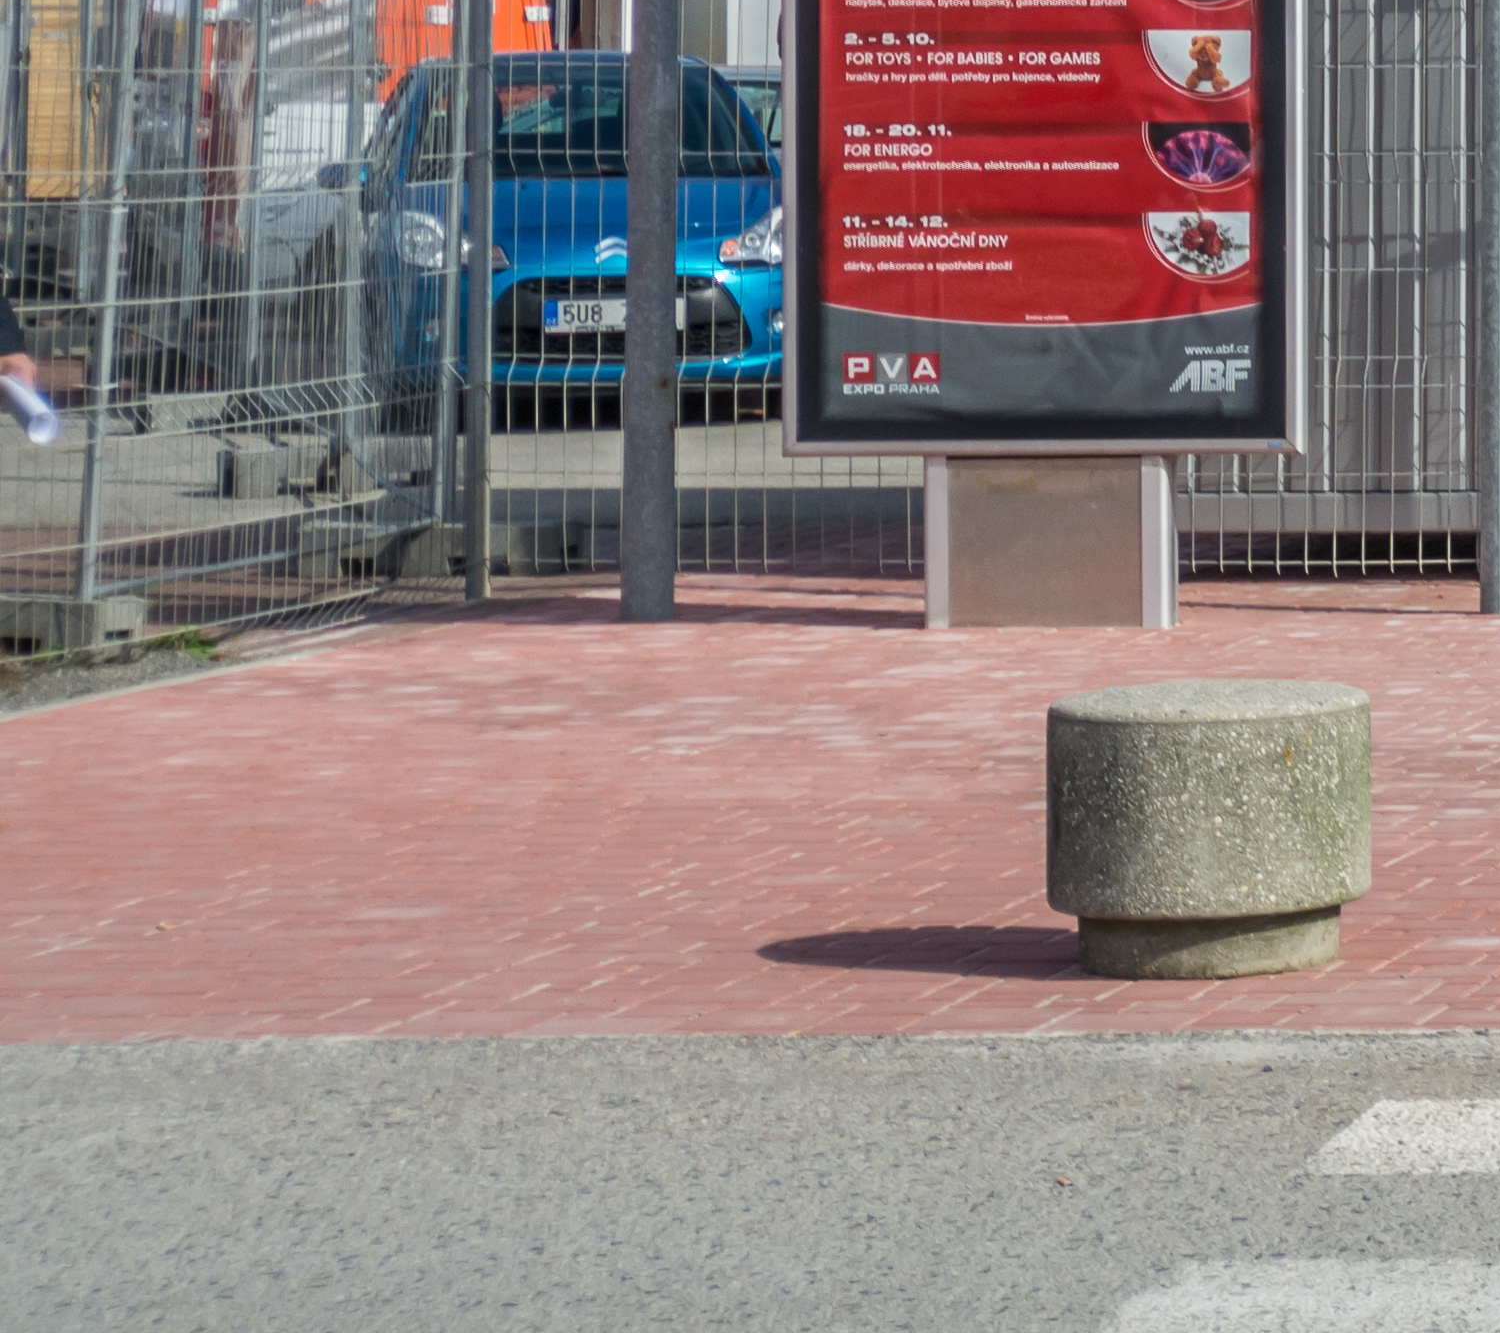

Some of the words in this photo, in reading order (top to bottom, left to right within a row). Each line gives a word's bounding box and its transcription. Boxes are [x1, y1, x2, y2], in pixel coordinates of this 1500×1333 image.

[846, 52, 874, 65] FOR
[876, 53, 912, 65] TOYS
[927, 52, 954, 65] FOR
[957, 52, 1003, 65] BABIES
[1019, 52, 1047, 65] FOR
[1050, 52, 1101, 65] GAMES
[844, 144, 871, 156] FOR
[874, 143, 933, 156] ENERGO
[843, 232, 904, 247] STŘÍBRNÉ
[908, 232, 976, 247] VÁNOČNÍ
[978, 235, 1008, 247] DNY
[563, 303, 603, 324] 5U8
[1184, 344, 1249, 356] www.abf.cz
[847, 357, 938, 380] PVA
[1169, 359, 1252, 394] ABF
[843, 384, 884, 395] EXPO
[889, 384, 940, 395] PRAHA
